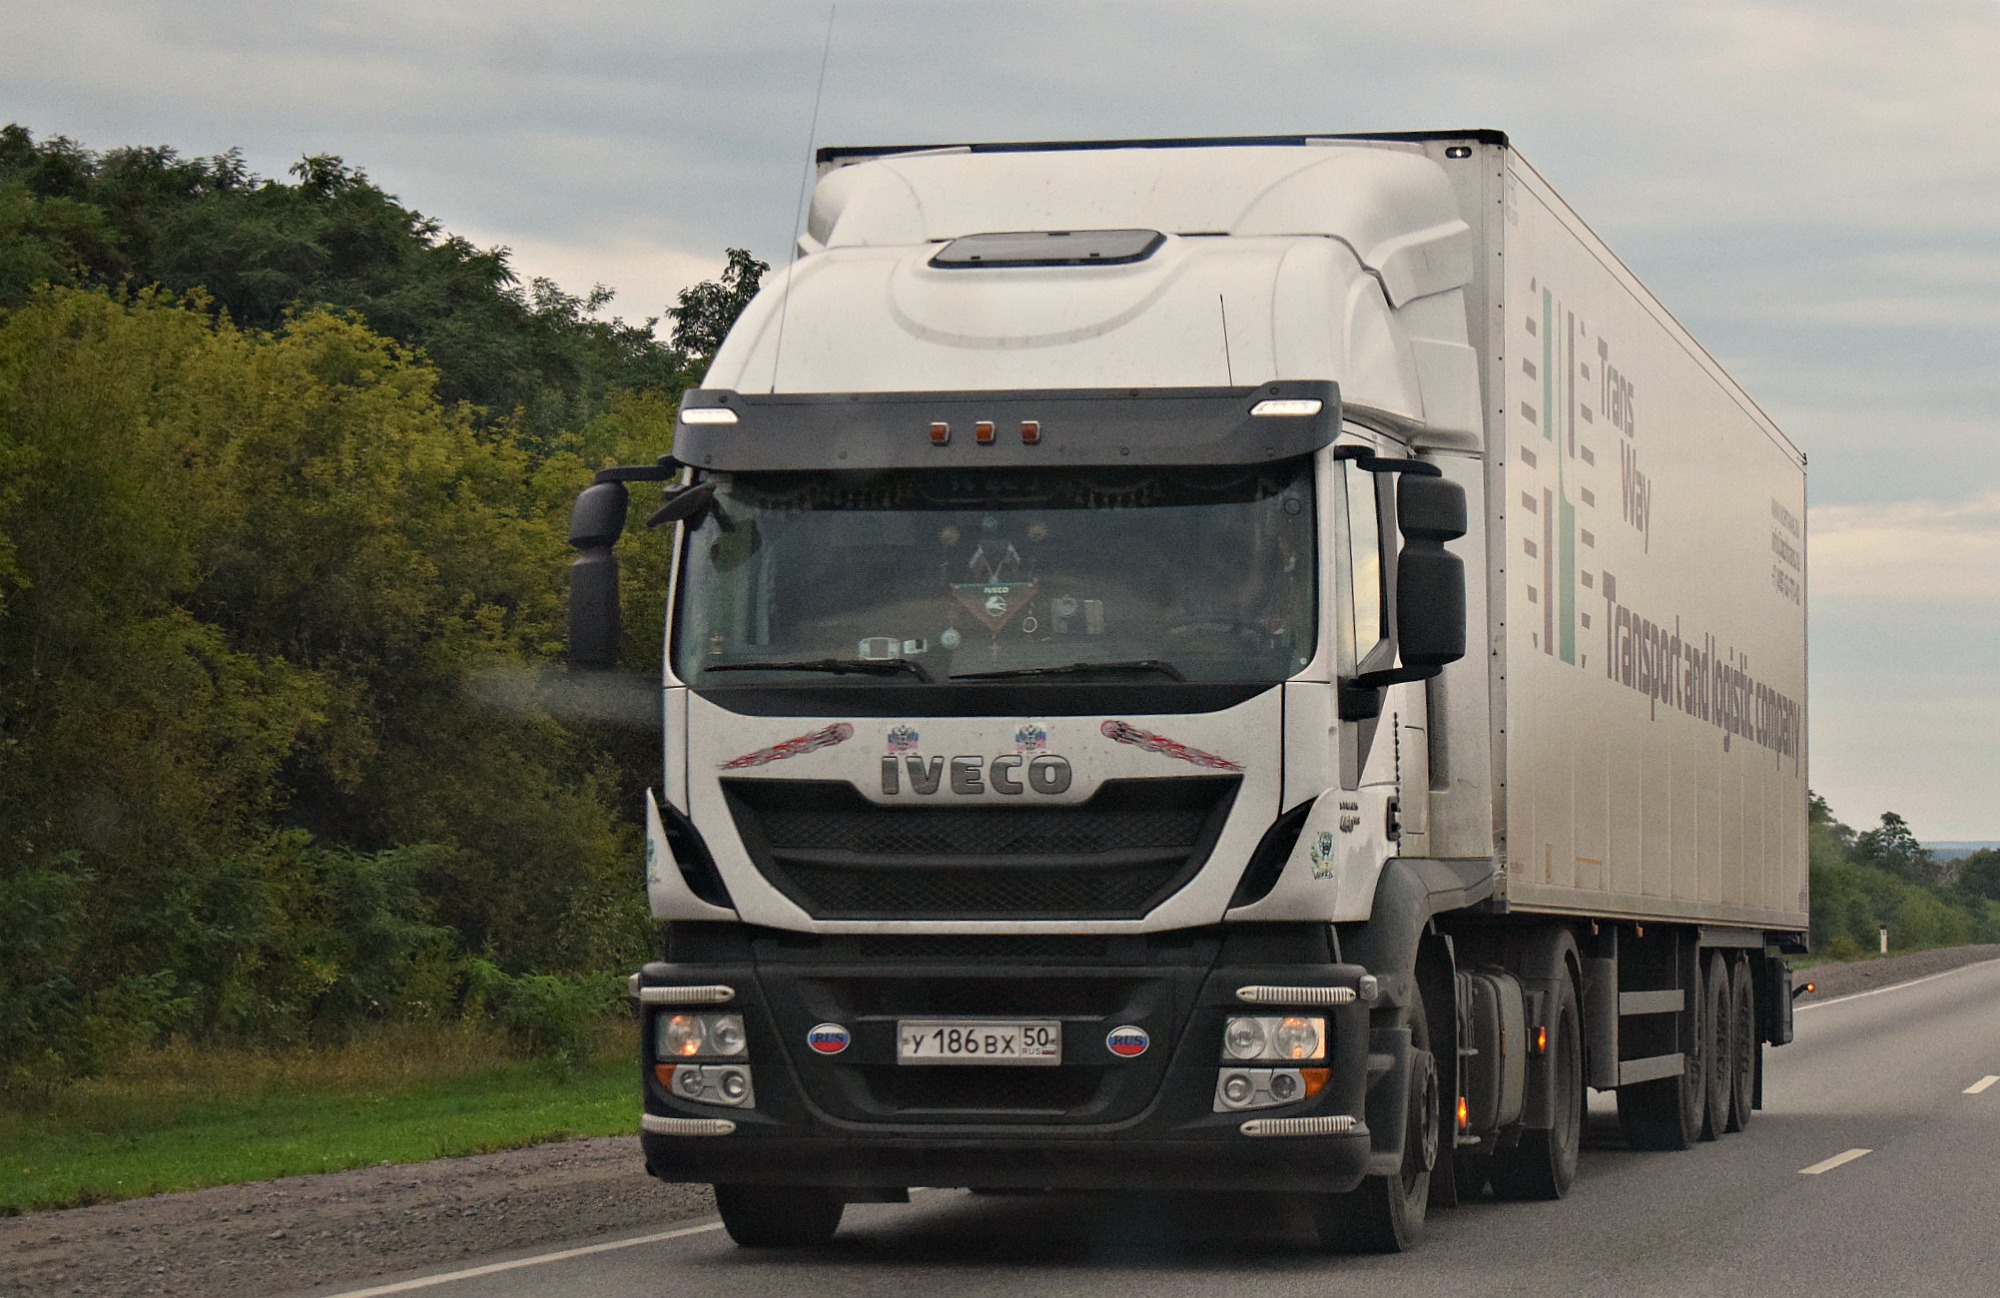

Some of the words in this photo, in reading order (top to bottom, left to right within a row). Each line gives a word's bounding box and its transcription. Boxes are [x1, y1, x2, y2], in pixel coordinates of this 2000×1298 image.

[1598, 335, 1634, 439] Trans
[1620, 438, 1651, 554] Way
[1602, 570, 1682, 722] Transport
[1684, 632, 1709, 722] and
[1711, 634, 1753, 753] logistic
[1755, 681, 1800, 778] company
[881, 755, 1072, 795] IVECO
[814, 1033, 844, 1042] RUS
[1022, 1047, 1041, 1055] RUS
[1023, 1027, 1050, 1047] 50
[1114, 1035, 1143, 1045] RUS
